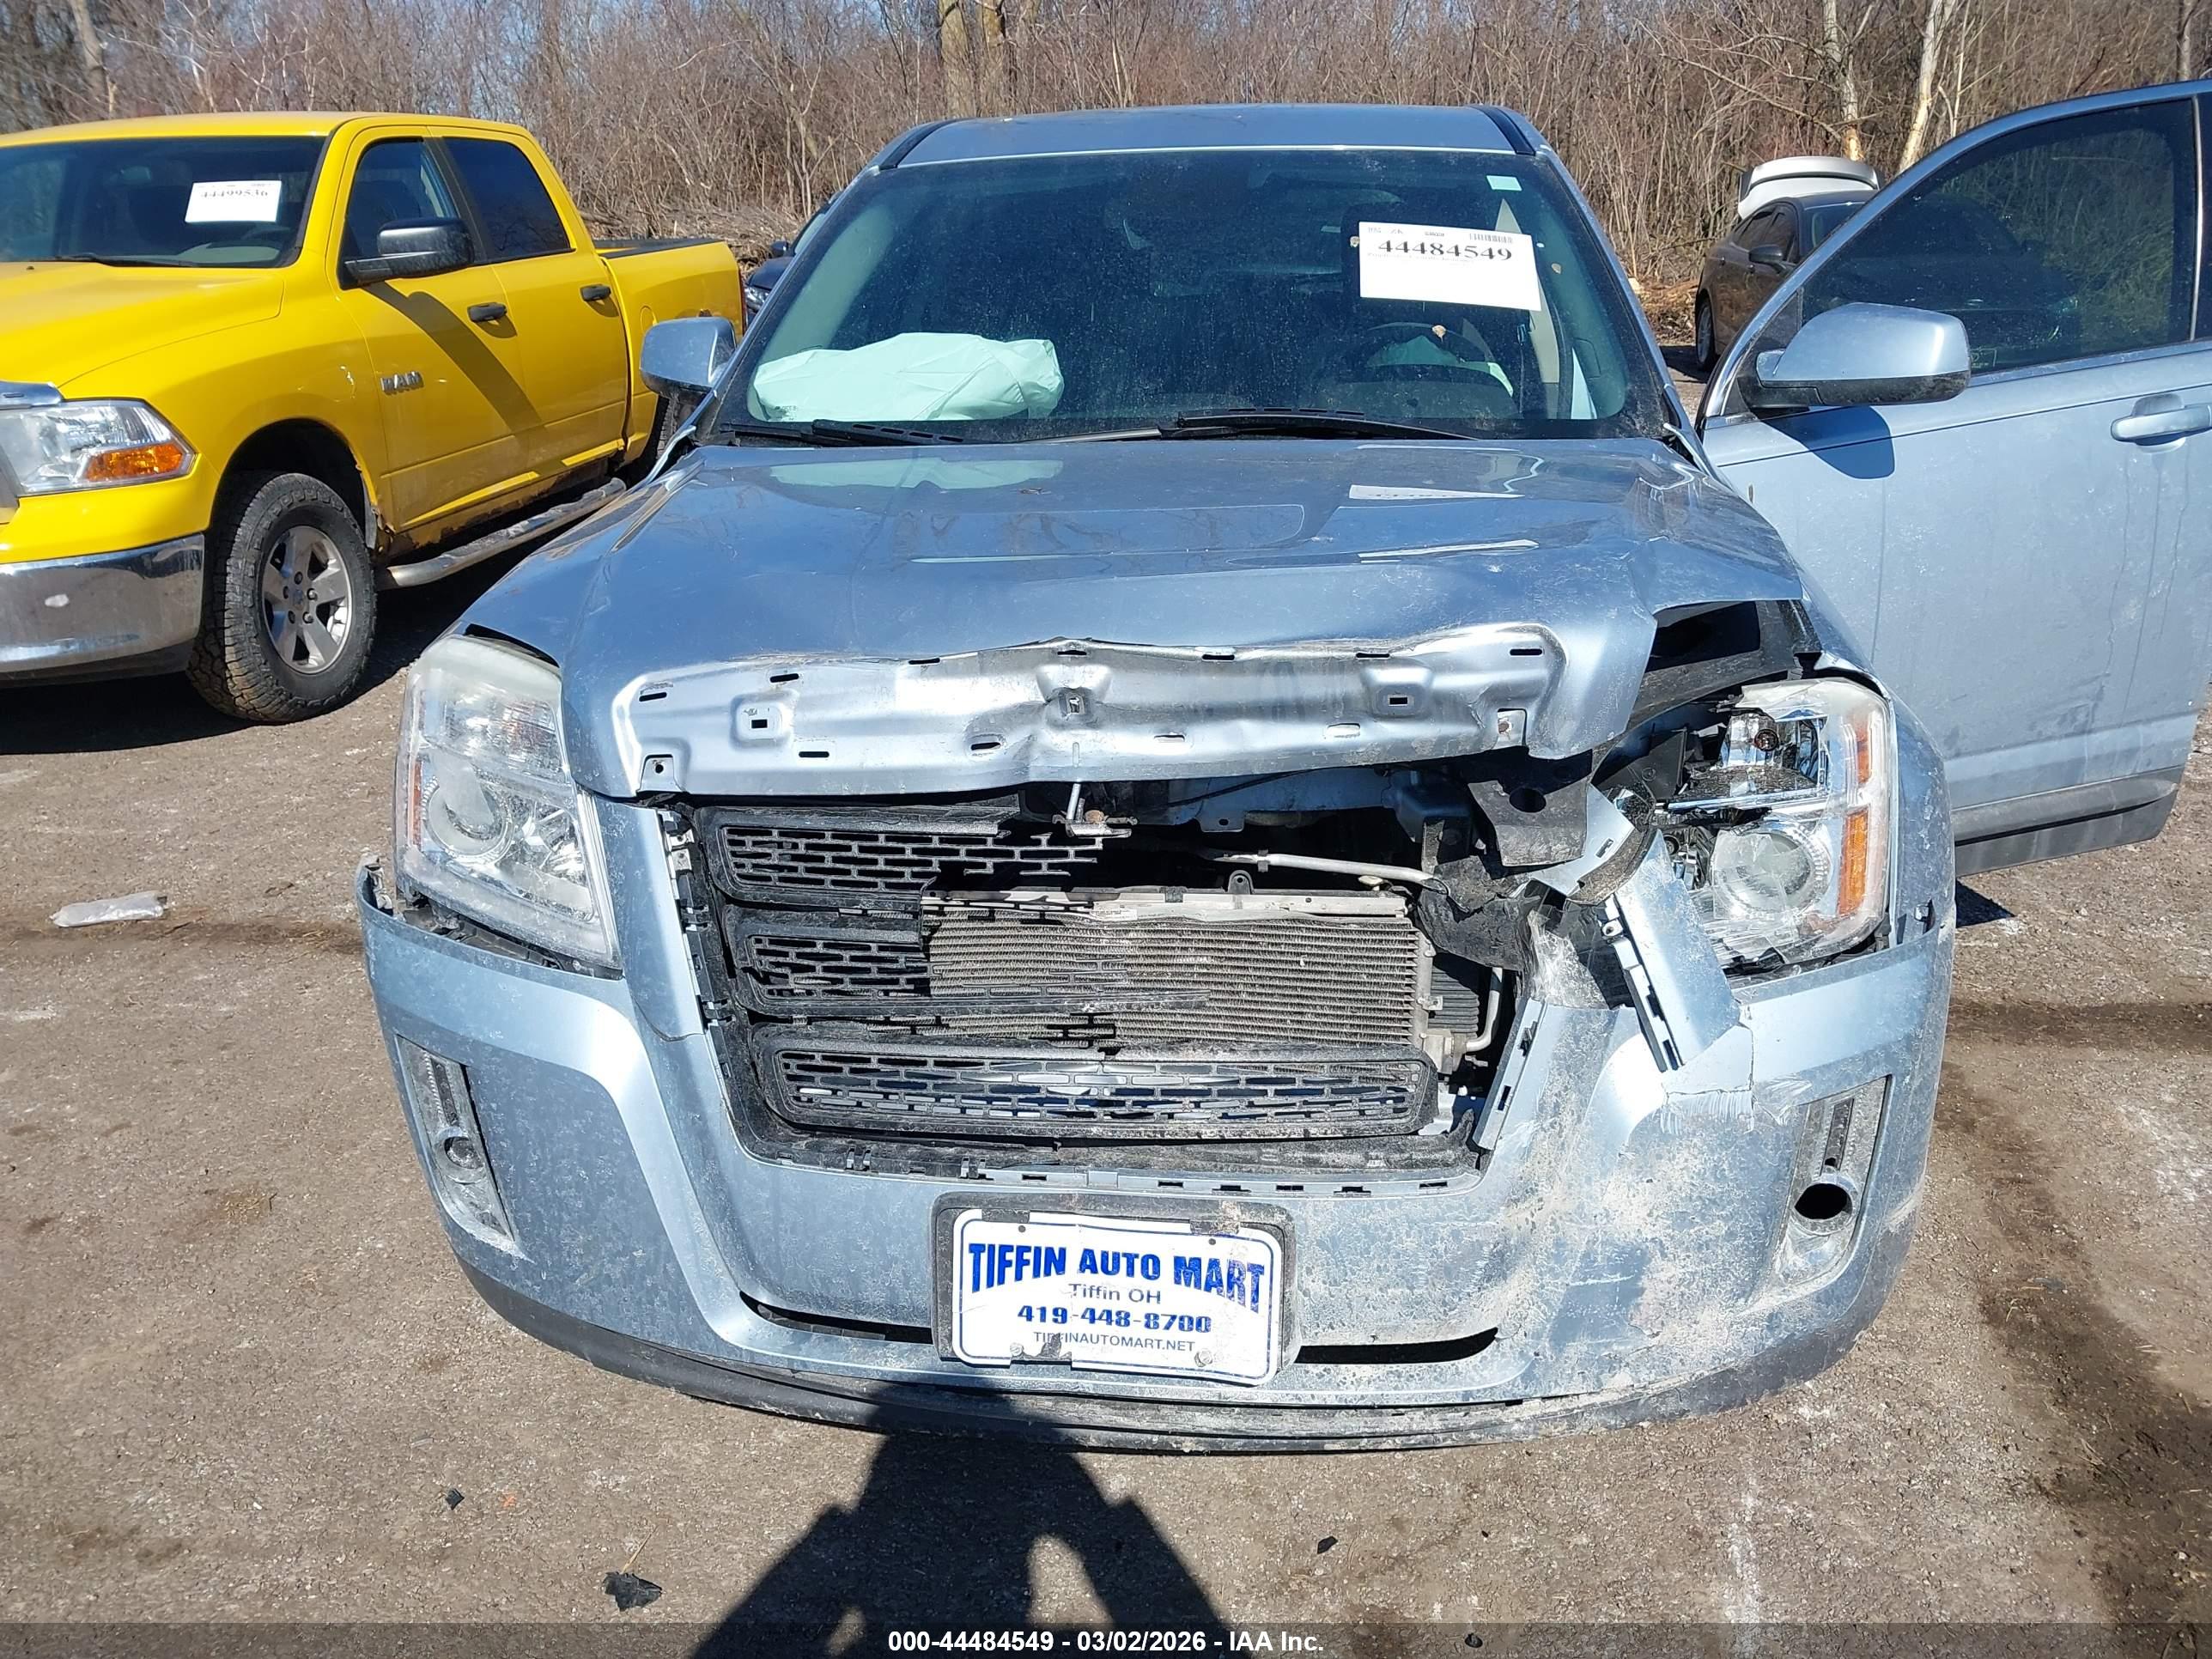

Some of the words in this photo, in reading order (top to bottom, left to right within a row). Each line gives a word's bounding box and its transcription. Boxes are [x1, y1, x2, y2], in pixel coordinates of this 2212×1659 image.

[1378, 240, 1512, 261] 44484549
[380, 370, 423, 392] RAM
[968, 1243, 1066, 1293] TIFFIN
[1079, 1248, 1161, 1280] AUTO
[1173, 1255, 1266, 1314] MART
[1068, 1283, 1120, 1301] Tiffin
[1128, 1288, 1161, 1304] OH
[1017, 1304, 1212, 1334] 419-448-8700
